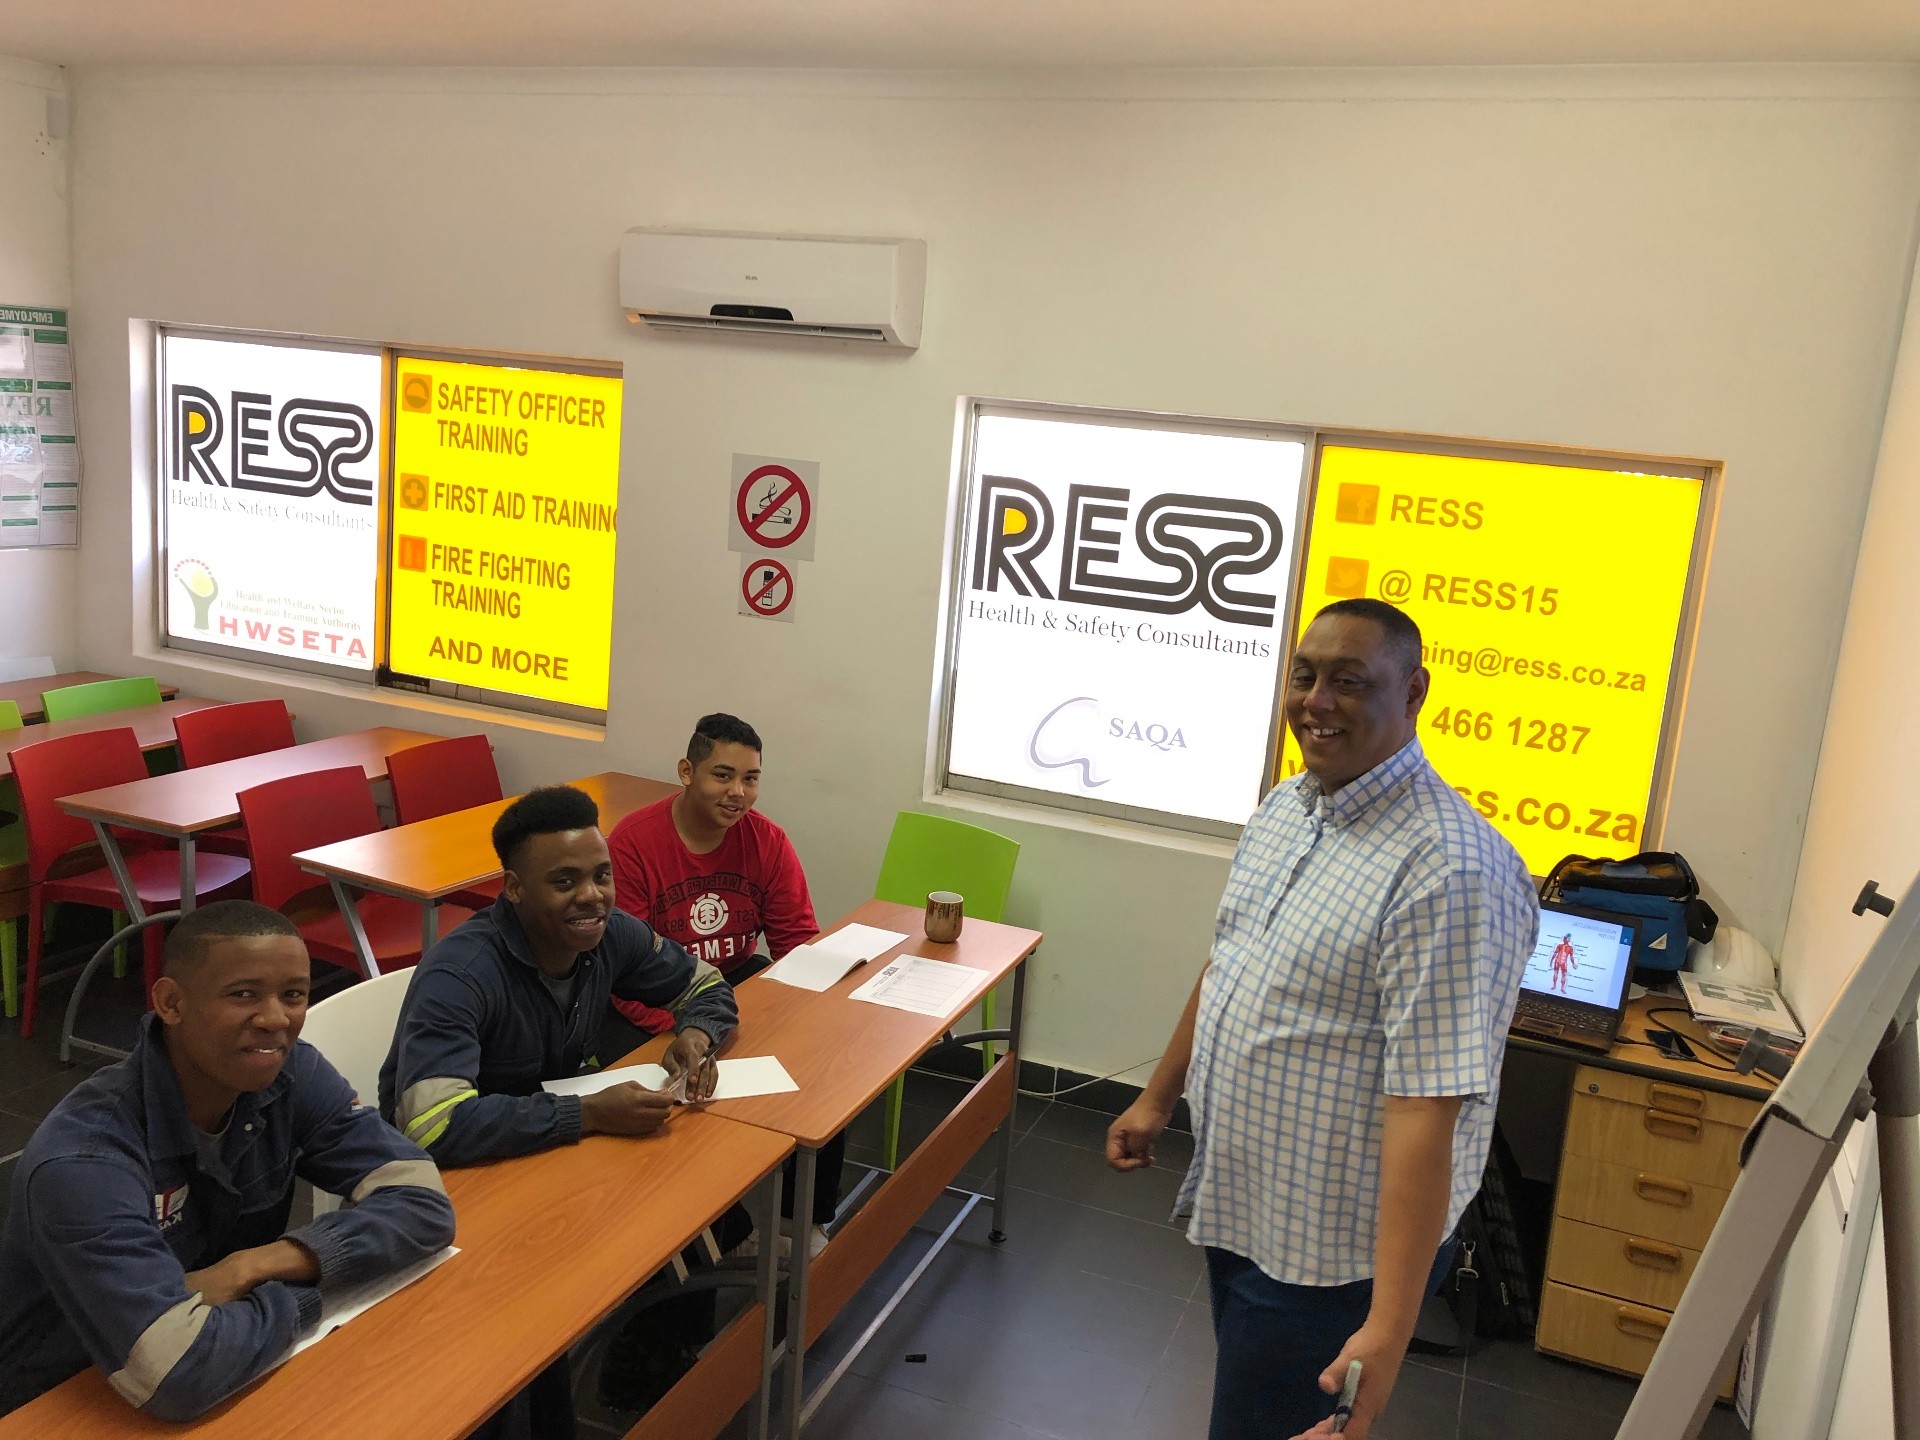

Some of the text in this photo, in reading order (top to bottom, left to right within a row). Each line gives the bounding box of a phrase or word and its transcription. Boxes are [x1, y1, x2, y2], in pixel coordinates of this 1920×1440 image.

[438, 382, 605, 428] SAFETY OFFICER
[437, 419, 528, 457] TRAINING
[172, 489, 374, 531] Health & Safety Consultants
[434, 482, 488, 515] FIRST
[492, 490, 525, 520] AID
[1390, 494, 1484, 530] RESS
[432, 544, 570, 591] FIRE FIGHTING
[431, 580, 522, 619] TRAINING
[1379, 569, 1558, 616] @ RESS15
[219, 615, 367, 659] HWSETA
[969, 600, 1270, 659] Health & Safety Consultants
[428, 636, 569, 681] AND MORE
[1421, 641, 1646, 692] ning@ress.co.za
[1109, 718, 1187, 751] SAQA
[1431, 706, 1591, 755] 466 1287
